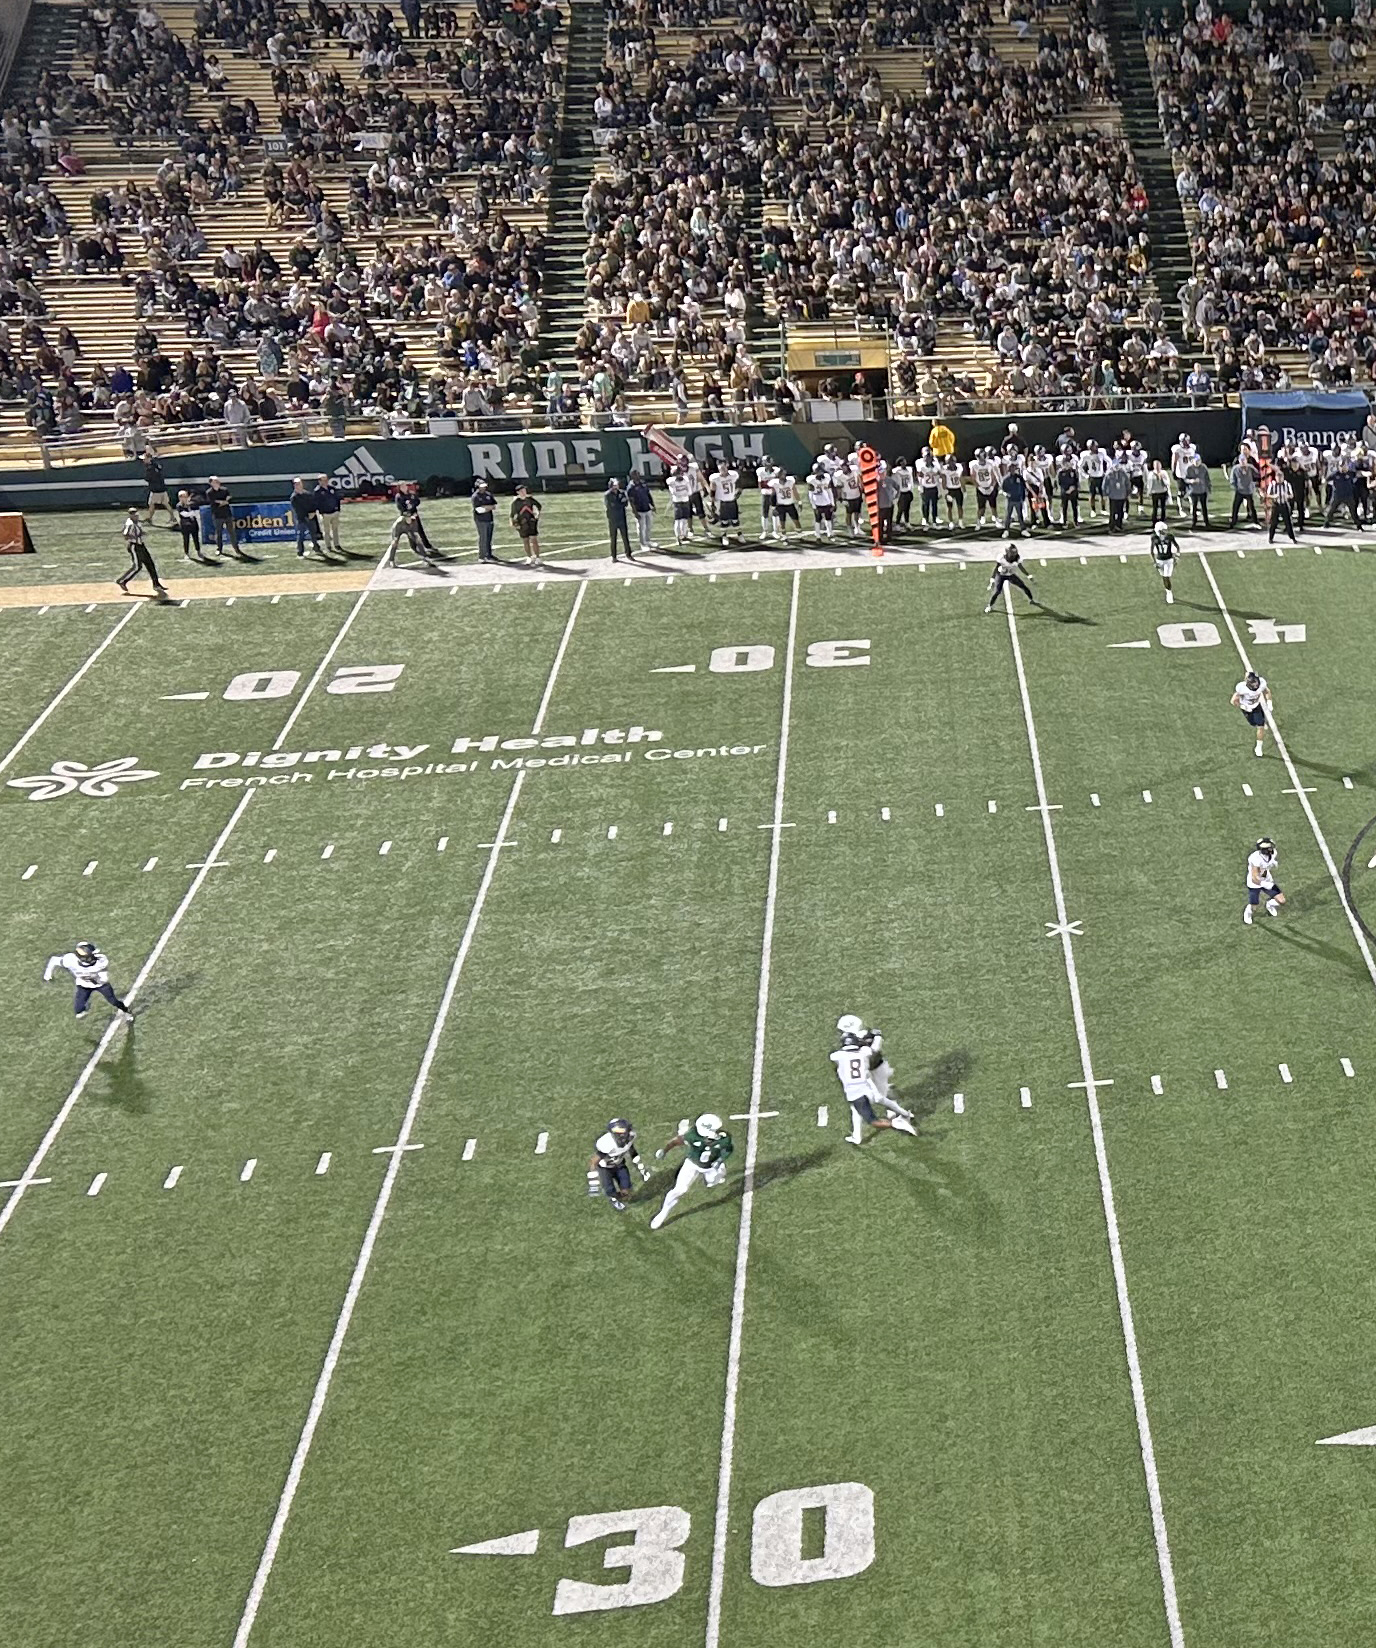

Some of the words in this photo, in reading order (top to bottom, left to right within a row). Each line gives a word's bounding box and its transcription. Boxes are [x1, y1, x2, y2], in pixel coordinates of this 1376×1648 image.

[267, 141, 284, 151] 101
[467, 439, 605, 479] RIDE
[626, 433, 765, 476] HGH
[327, 473, 396, 490] adidas
[232, 514, 284, 529] olden
[248, 528, 272, 537] Credit
[192, 742, 430, 771] Dignity
[450, 727, 664, 755] Health
[179, 772, 314, 792] French
[326, 759, 478, 783] Hospital
[490, 751, 633, 772] Medical
[643, 743, 768, 762] Center
[849, 1058, 862, 1080] 8
[551, 1481, 876, 1617] 30
